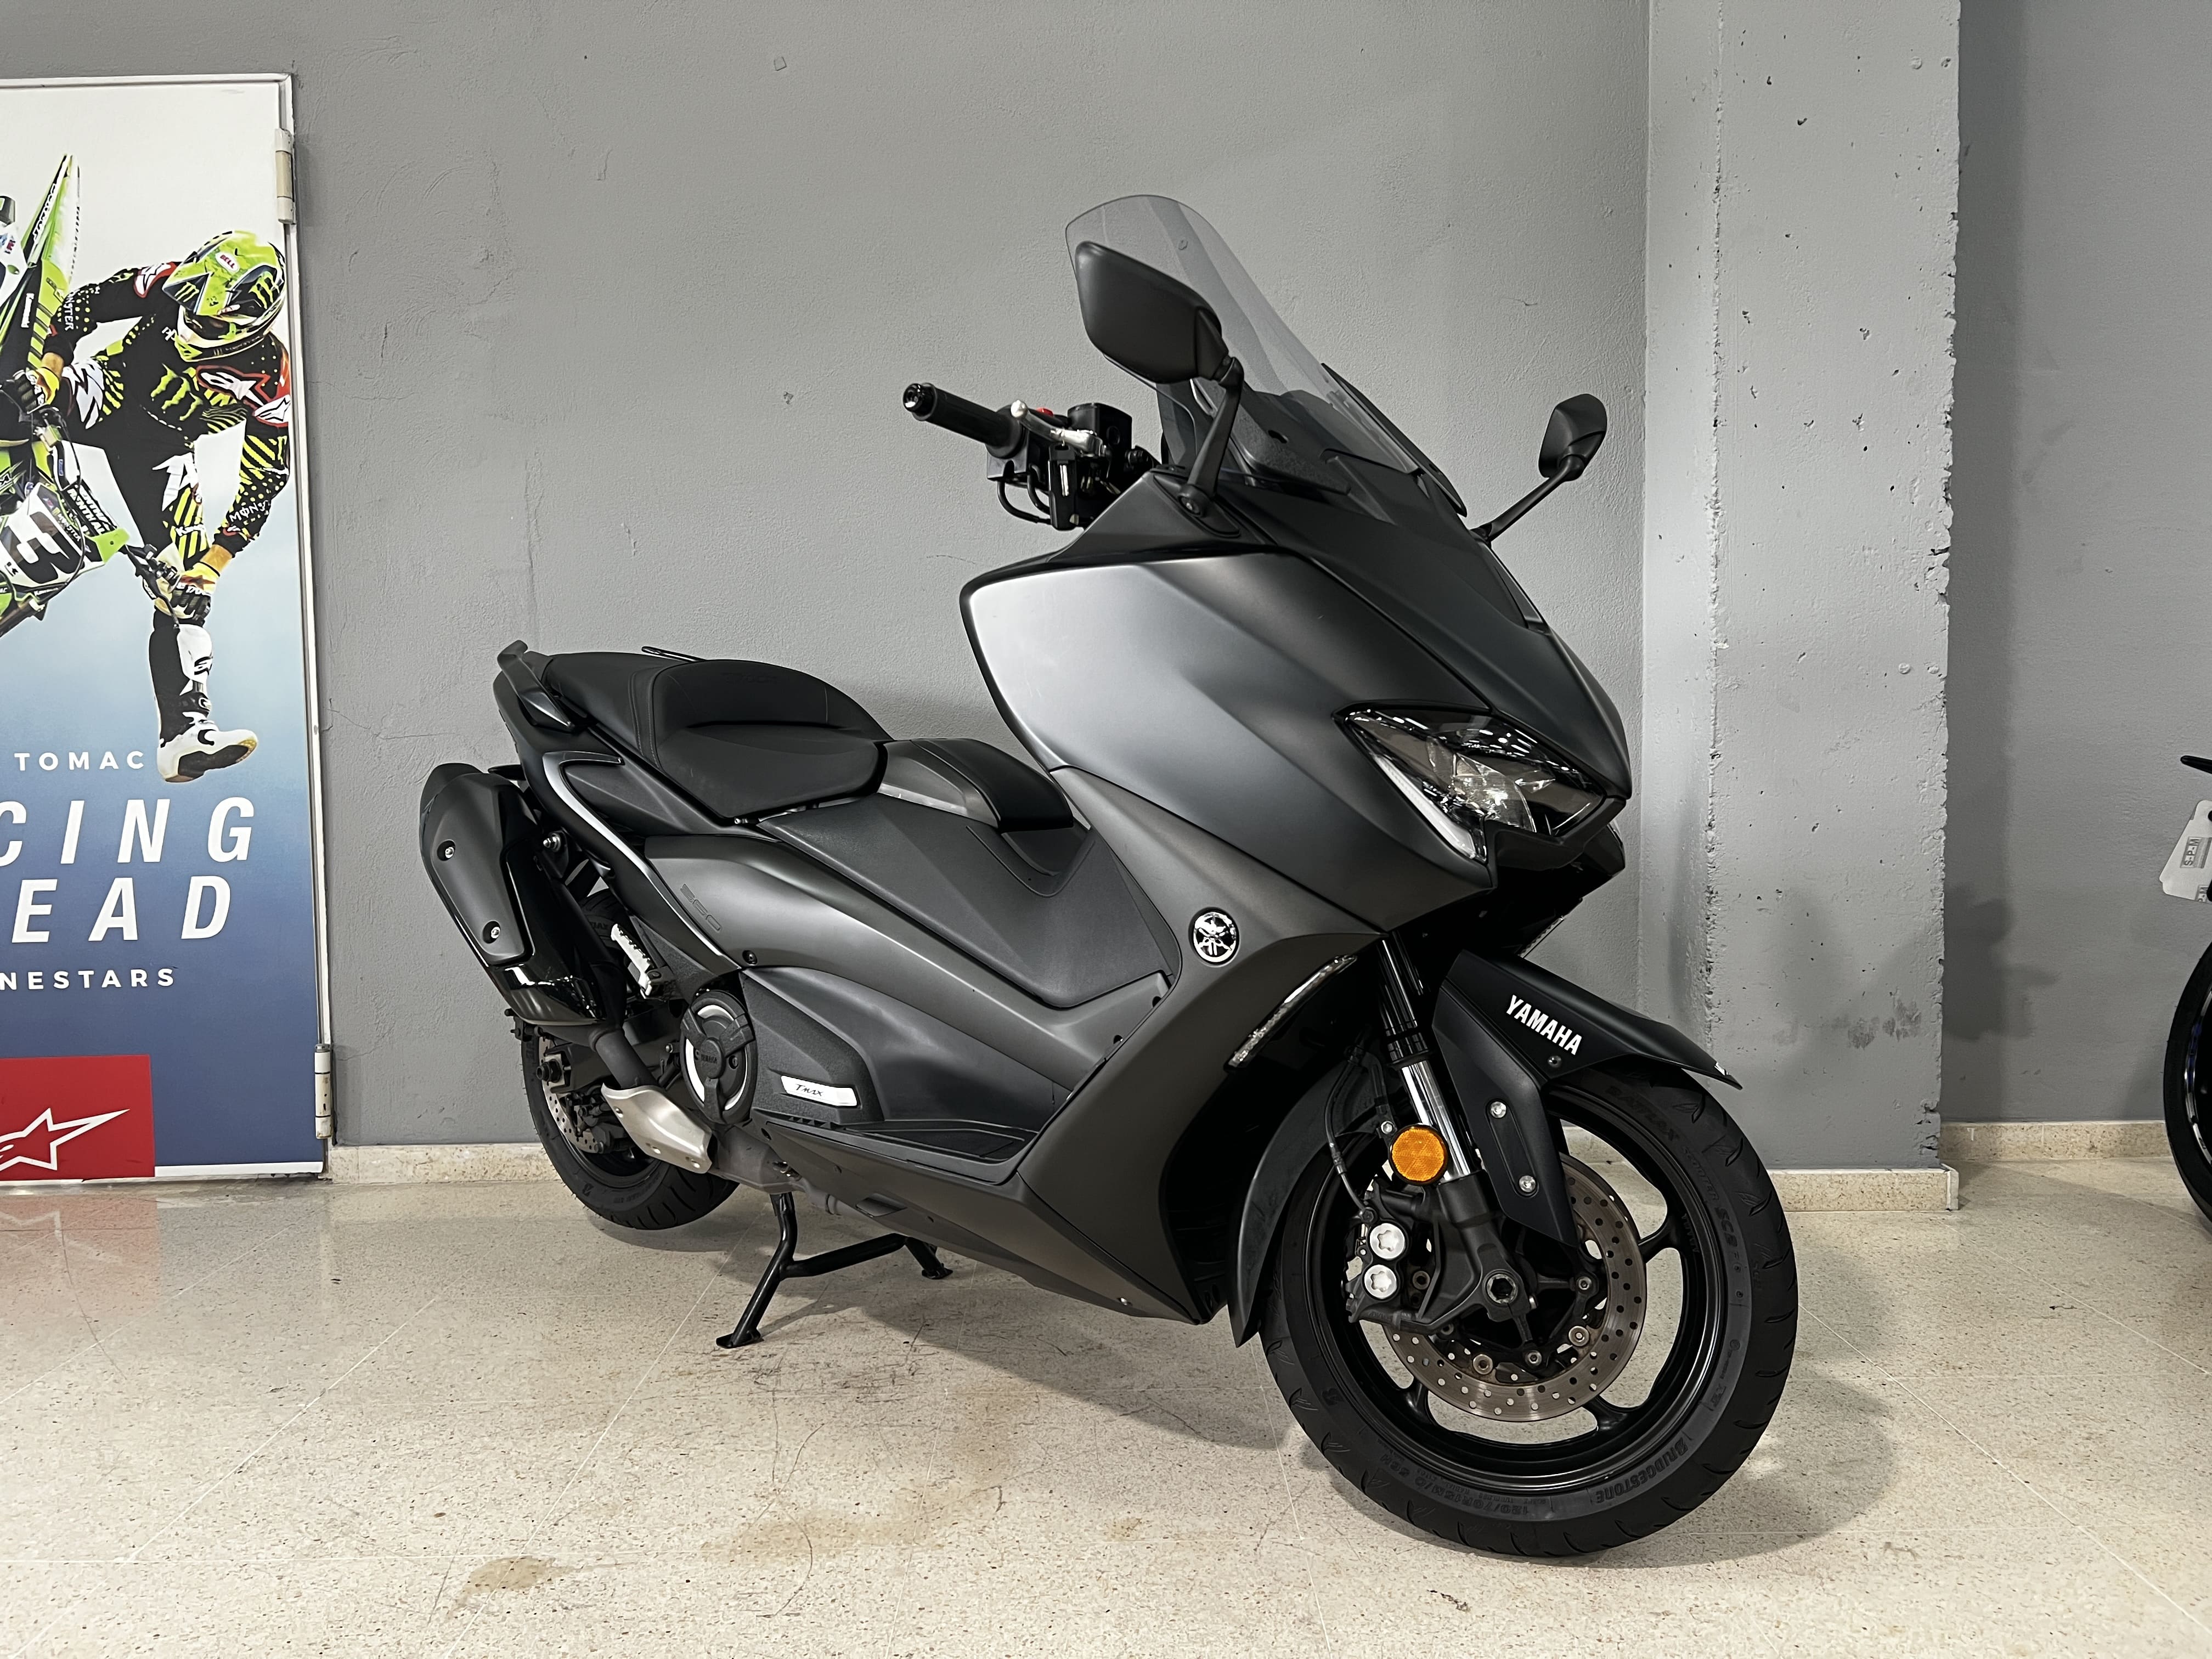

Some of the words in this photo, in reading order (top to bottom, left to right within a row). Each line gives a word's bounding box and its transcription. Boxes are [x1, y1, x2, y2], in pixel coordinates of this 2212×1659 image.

[220, 254, 235, 269] BELL
[14, 751, 144, 771] TOMAC
[0, 797, 254, 867] CING
[12, 876, 230, 943] EAD
[0, 968, 174, 990] NESTARS
[1506, 994, 1582, 1056] YAMAHA
[1595, 1437, 1689, 1504] BRIDGESTONE
